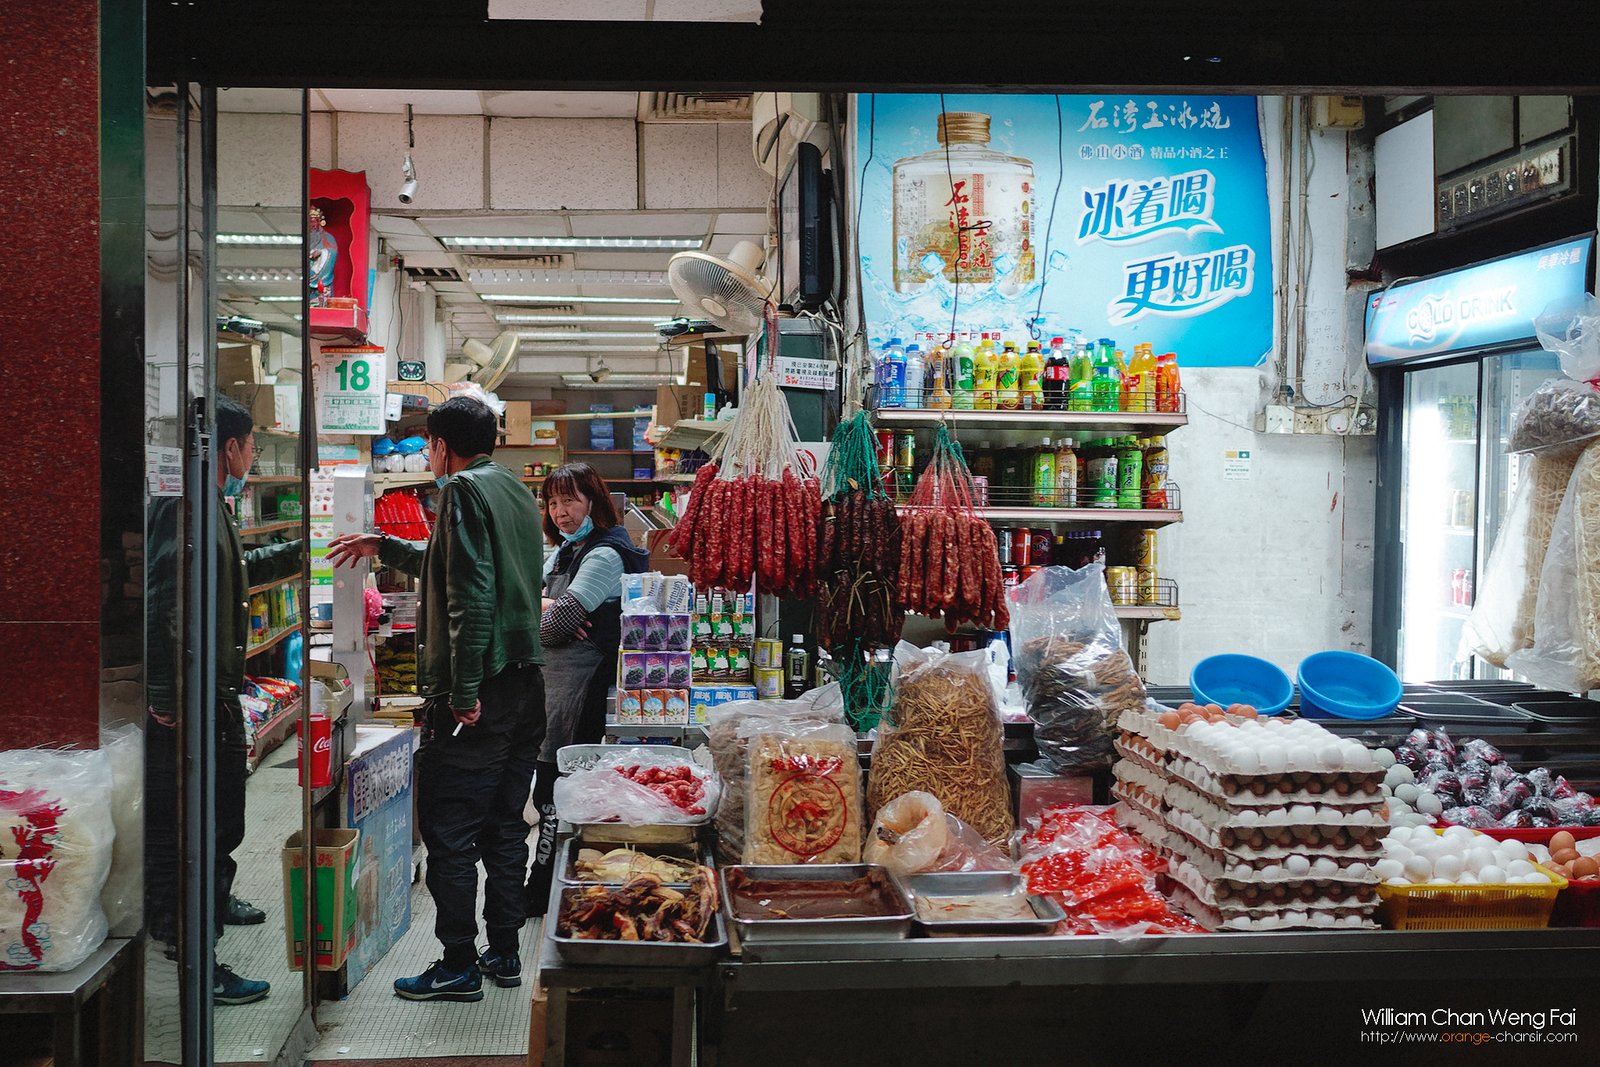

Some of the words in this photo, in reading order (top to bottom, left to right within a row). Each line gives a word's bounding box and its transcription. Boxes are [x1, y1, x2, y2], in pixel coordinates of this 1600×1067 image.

[1079, 144, 1144, 160] 佛山小酒
[1150, 146, 1229, 159] 精品小酒之王
[1078, 173, 1208, 239] 冰着喝
[1114, 248, 1249, 318] 更好喝
[1407, 296, 1454, 336] COLD
[1459, 290, 1515, 322] DRINK
[334, 360, 371, 392] 18
